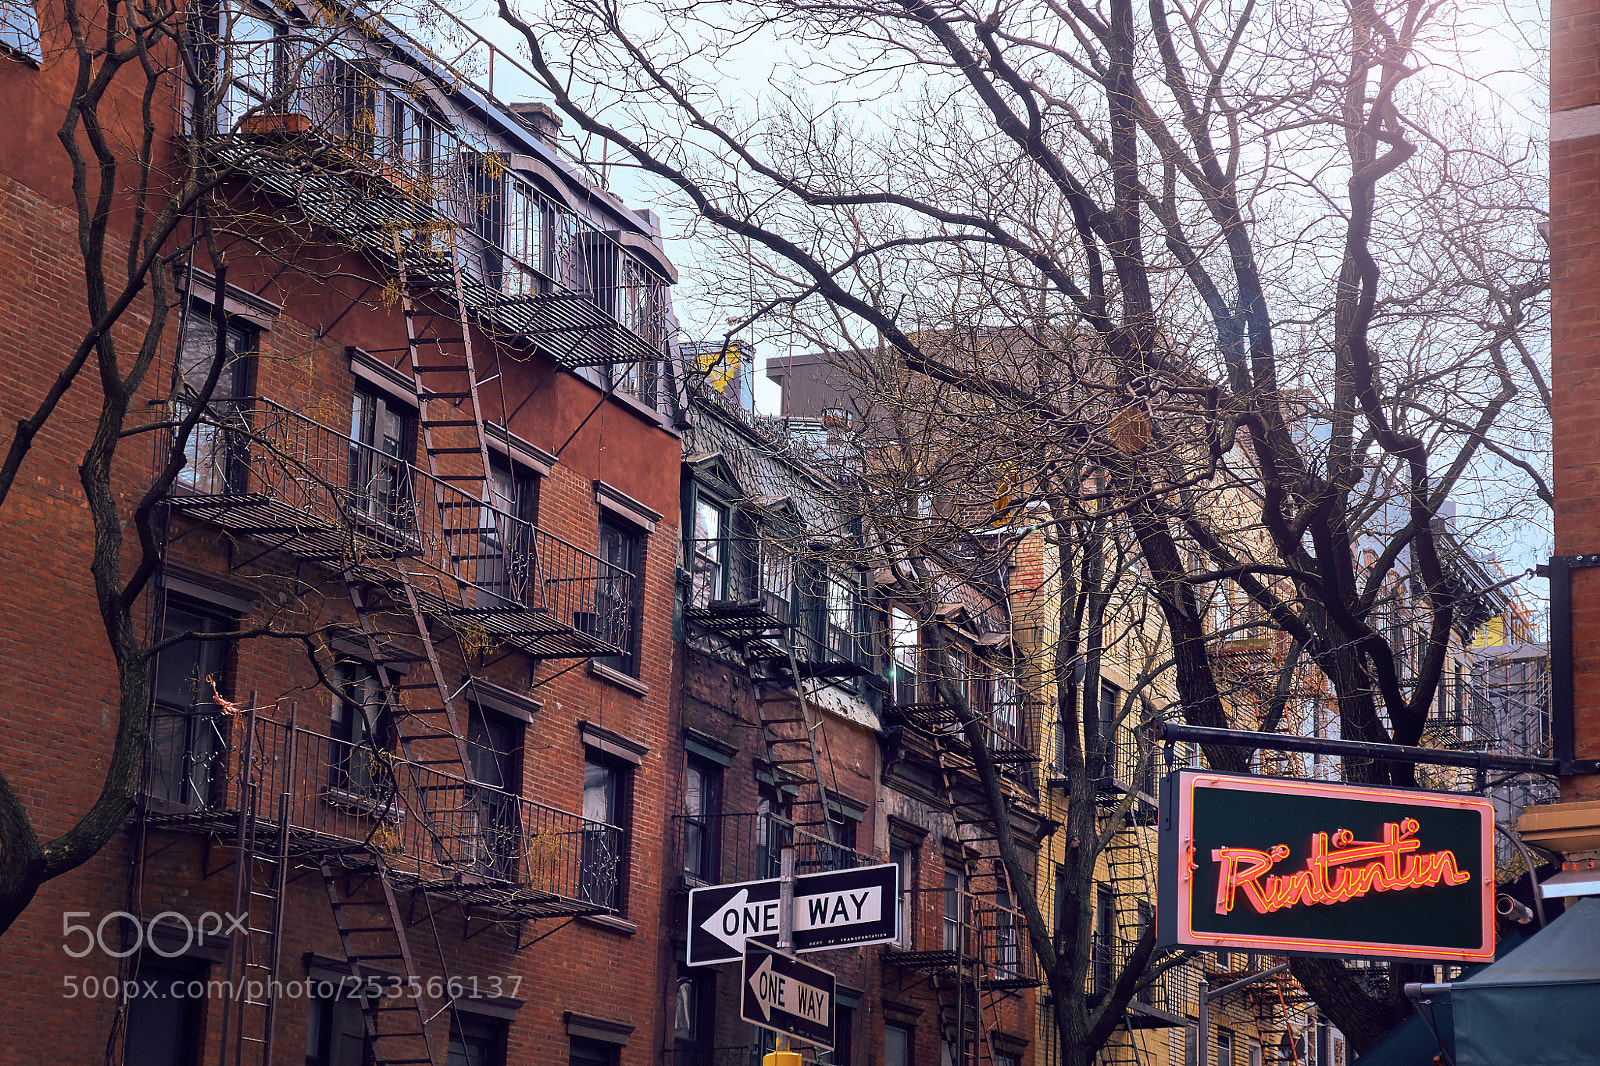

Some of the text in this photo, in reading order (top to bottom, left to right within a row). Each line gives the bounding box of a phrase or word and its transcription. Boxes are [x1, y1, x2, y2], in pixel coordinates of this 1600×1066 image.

[1212, 817, 1470, 915] Rintintin
[722, 891, 869, 936] ONE WAY
[840, 933, 887, 943] TRANSPORTATION
[759, 970, 824, 1021] ONE WAY
